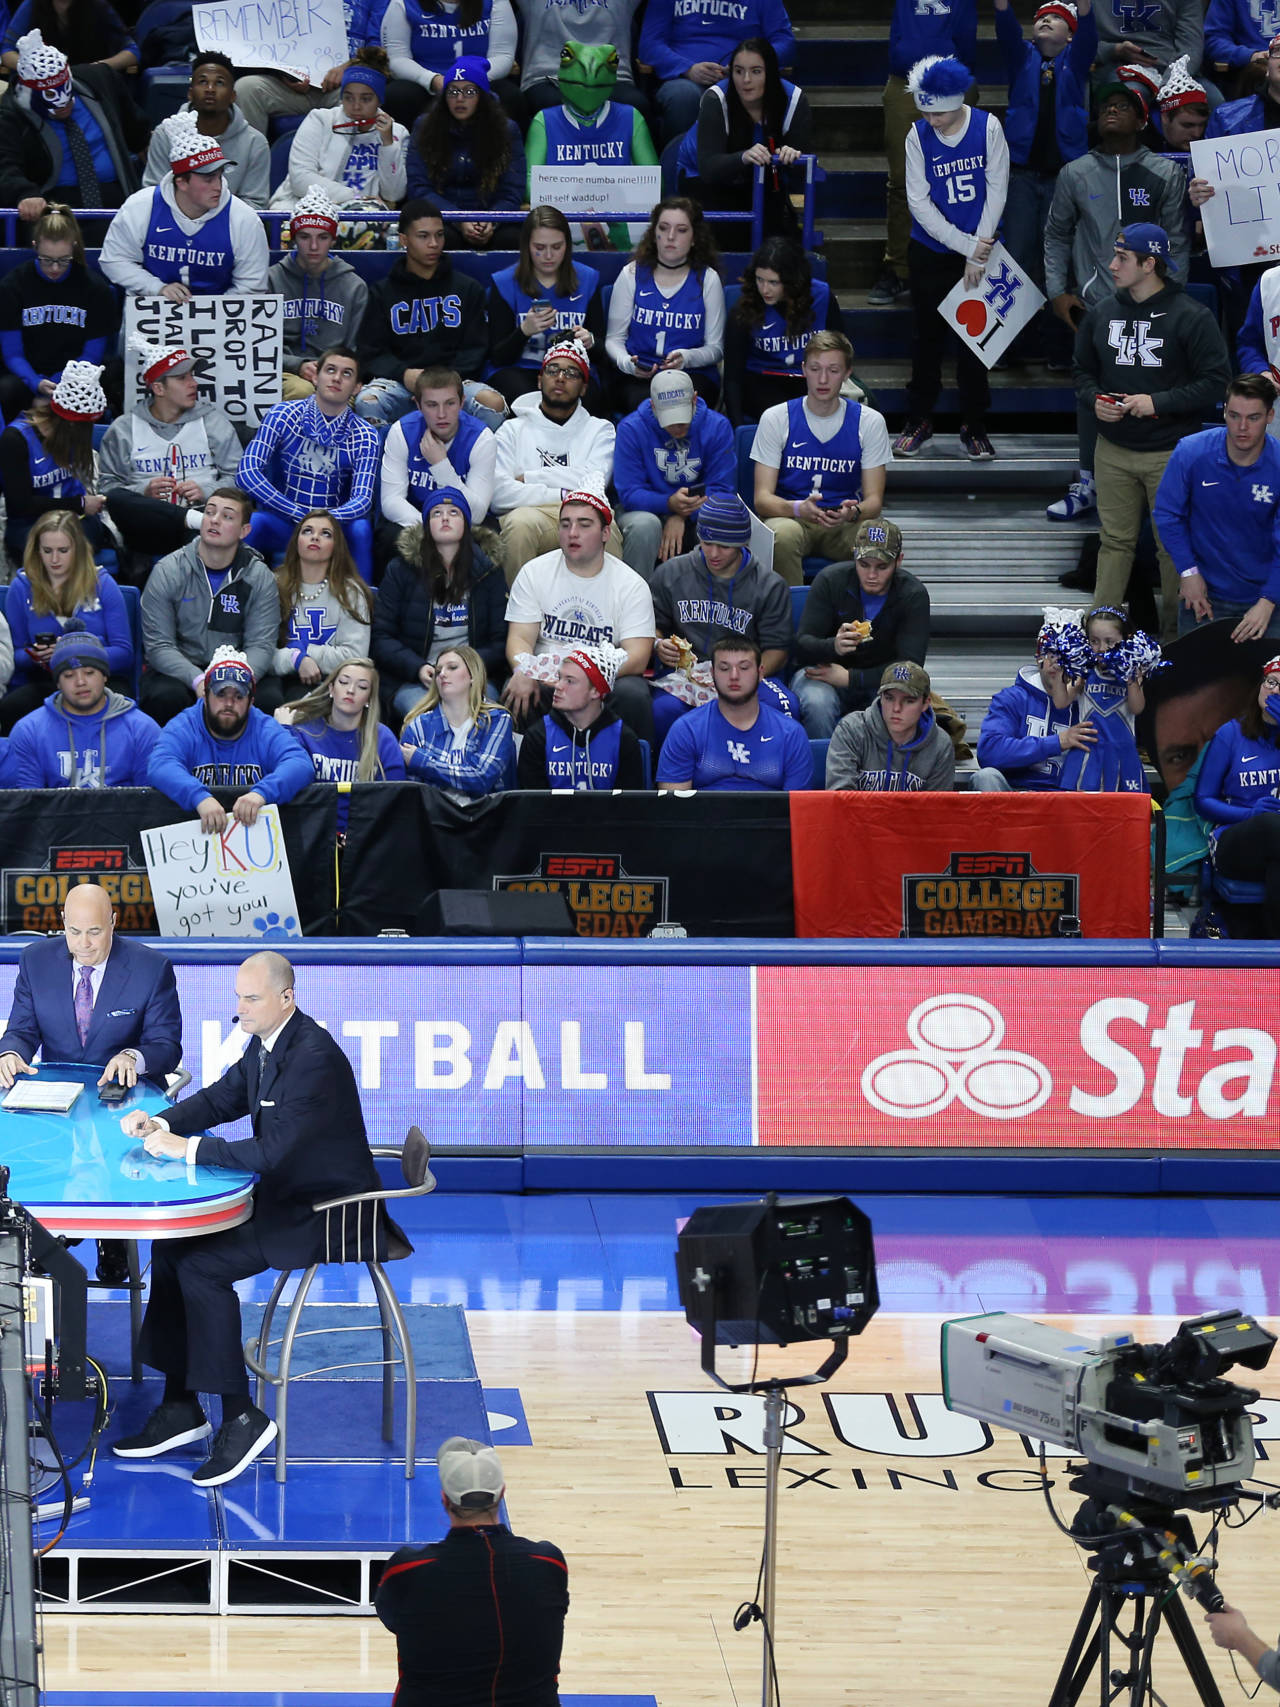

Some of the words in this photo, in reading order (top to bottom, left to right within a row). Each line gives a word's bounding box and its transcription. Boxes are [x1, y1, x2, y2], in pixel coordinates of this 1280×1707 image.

[673, 0, 748, 20] KENTUCKY
[455, 69, 466, 81] K
[557, 142, 624, 160] KENTUCKY
[539, 175, 559, 183] here
[560, 176, 584, 184] come
[586, 175, 616, 184] numba
[944, 175, 976, 204] 15
[539, 194, 552, 203] bill
[554, 193, 569, 202] self
[571, 192, 609, 204] waddup!
[1128, 188, 1149, 206] UK
[1225, 183, 1280, 225] LI
[1148, 240, 1161, 254] UK
[148, 249, 225, 267] KENTUCKY
[179, 265, 190, 286] 1
[22, 305, 87, 328] KENTUCKY
[189, 301, 216, 321] I
[391, 295, 462, 336] CATS
[222, 300, 247, 373] DROP
[655, 331, 666, 357] 1
[975, 318, 1005, 352] I
[1108, 319, 1165, 367] UK
[652, 447, 703, 485] UK
[786, 455, 856, 475] KENTUCKY
[1251, 484, 1274, 503] UK
[867, 528, 888, 543] UK
[220, 594, 241, 614] UK
[677, 600, 753, 635] KENTUCKY
[543, 613, 613, 646] WILDCATS
[1086, 683, 1127, 698] KENTUCKY
[726, 740, 751, 764] UK
[1125, 780, 1140, 791] UK
[1239, 769, 1280, 787] KENT
[56, 850, 124, 869] ESPN
[147, 832, 209, 873] Hey
[547, 857, 615, 877] ESPN
[956, 855, 1025, 875] ESPN
[166, 877, 249, 911] you've
[915, 880, 1064, 911] COLLEGE
[179, 903, 215, 936] got
[576, 912, 648, 938] EDAY
[922, 909, 1057, 936] GAMEDAY
[1081, 1419, 1088, 1432] F
